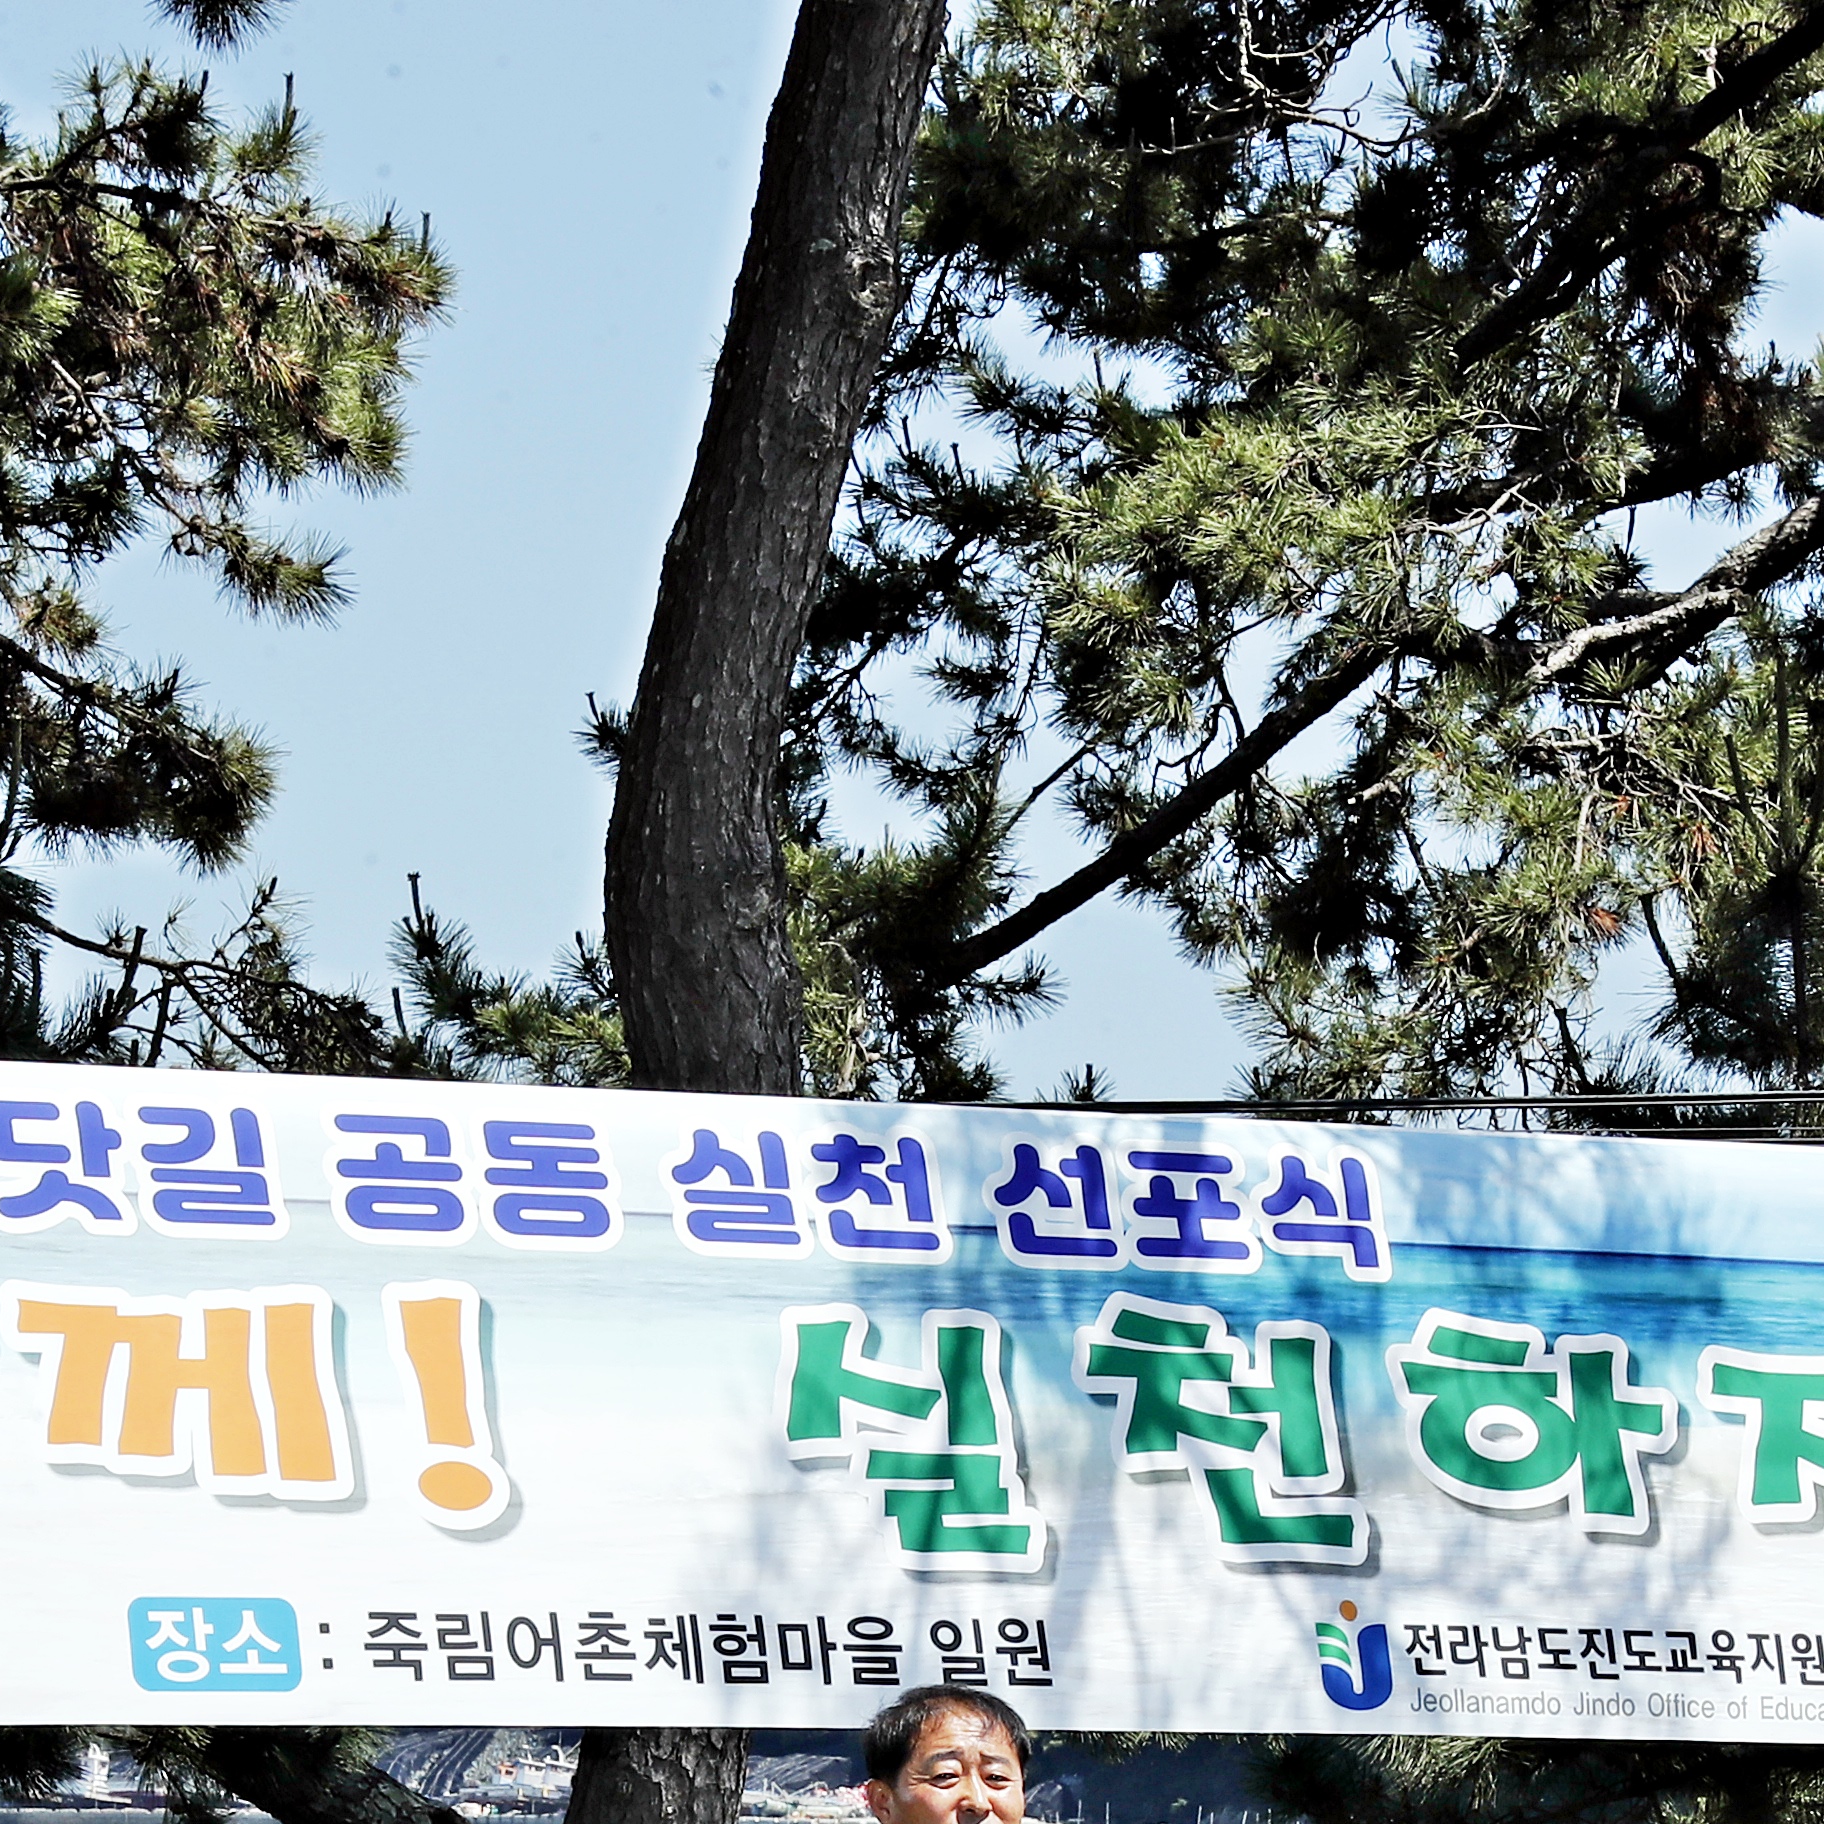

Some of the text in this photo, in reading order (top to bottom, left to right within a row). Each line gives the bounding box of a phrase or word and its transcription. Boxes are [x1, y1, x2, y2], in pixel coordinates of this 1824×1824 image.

[333, 1112, 613, 1240] 공동
[671, 1127, 943, 1253] 실천
[991, 1141, 1384, 1272] 선포식
[142, 1606, 291, 1683] 장소
[361, 1609, 906, 1685] 죽림어촌체험마을
[930, 1614, 1055, 1687] 일원
[1409, 1686, 1562, 1717] Jeollanamdo
[1572, 1690, 1636, 1717] Jindo
[1646, 1691, 1716, 1720] Office
[1726, 1695, 1749, 1720] of
